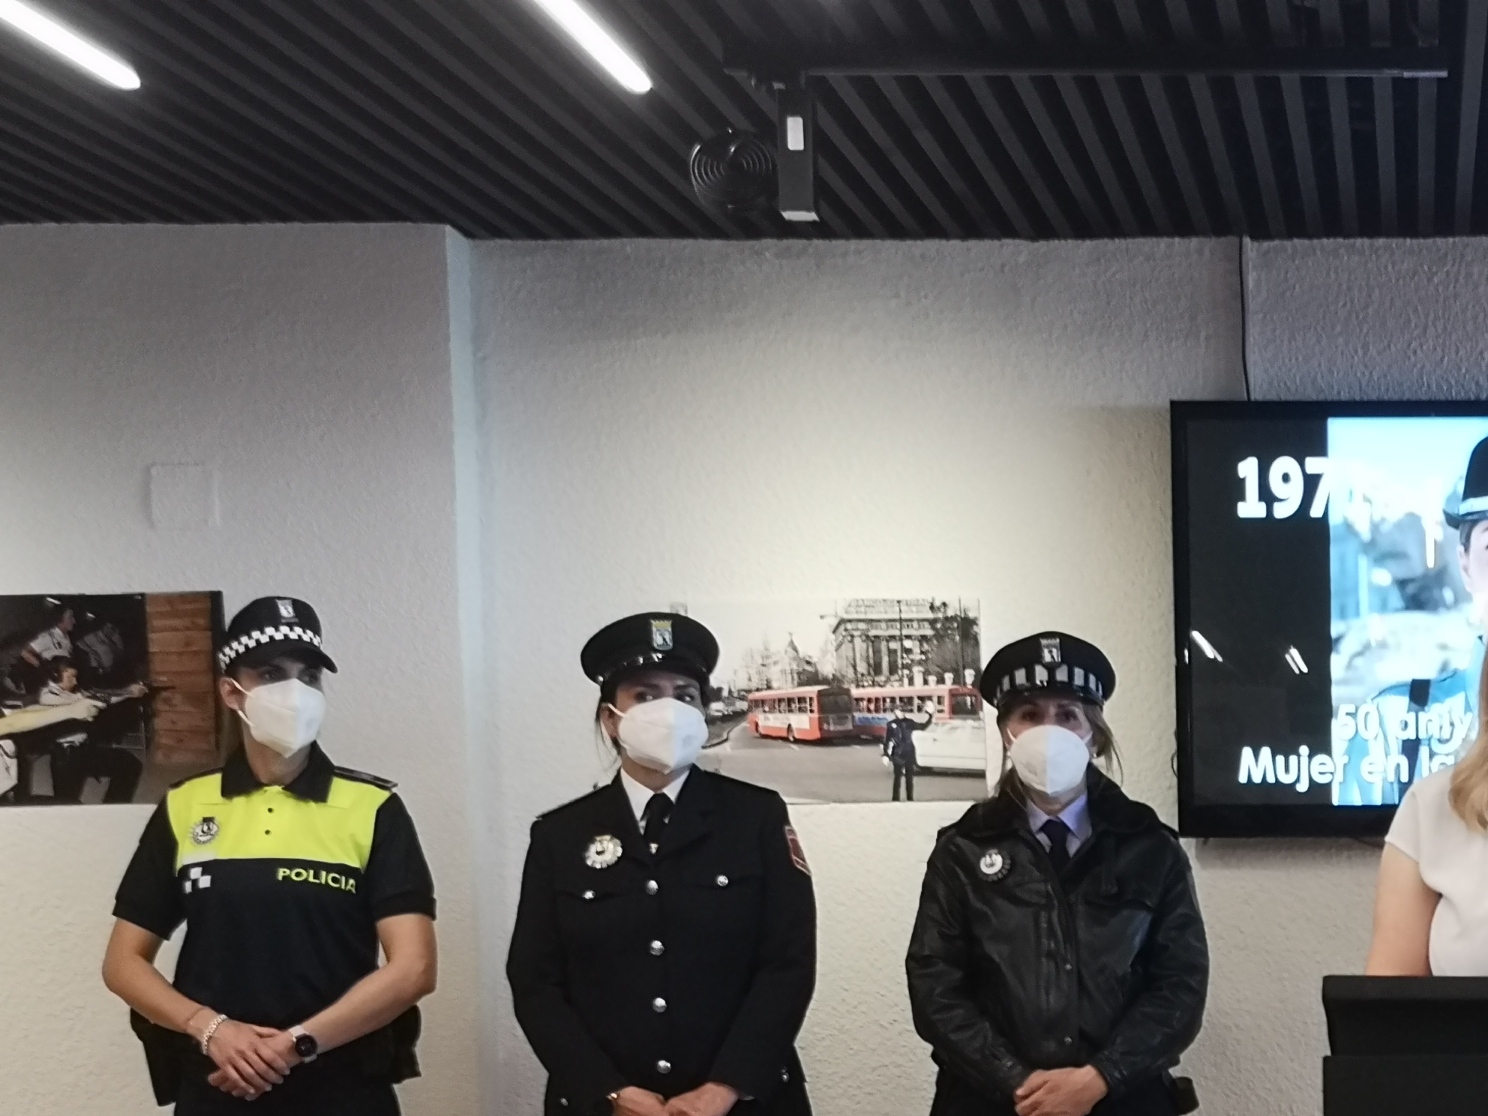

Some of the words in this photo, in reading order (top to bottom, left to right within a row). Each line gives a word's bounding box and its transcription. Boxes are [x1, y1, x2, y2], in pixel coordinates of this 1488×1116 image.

[1336, 703, 1380, 740] 50
[1238, 745, 1349, 793] Mujer
[1360, 754, 1409, 783] en
[277, 867, 357, 894] POLICIA
